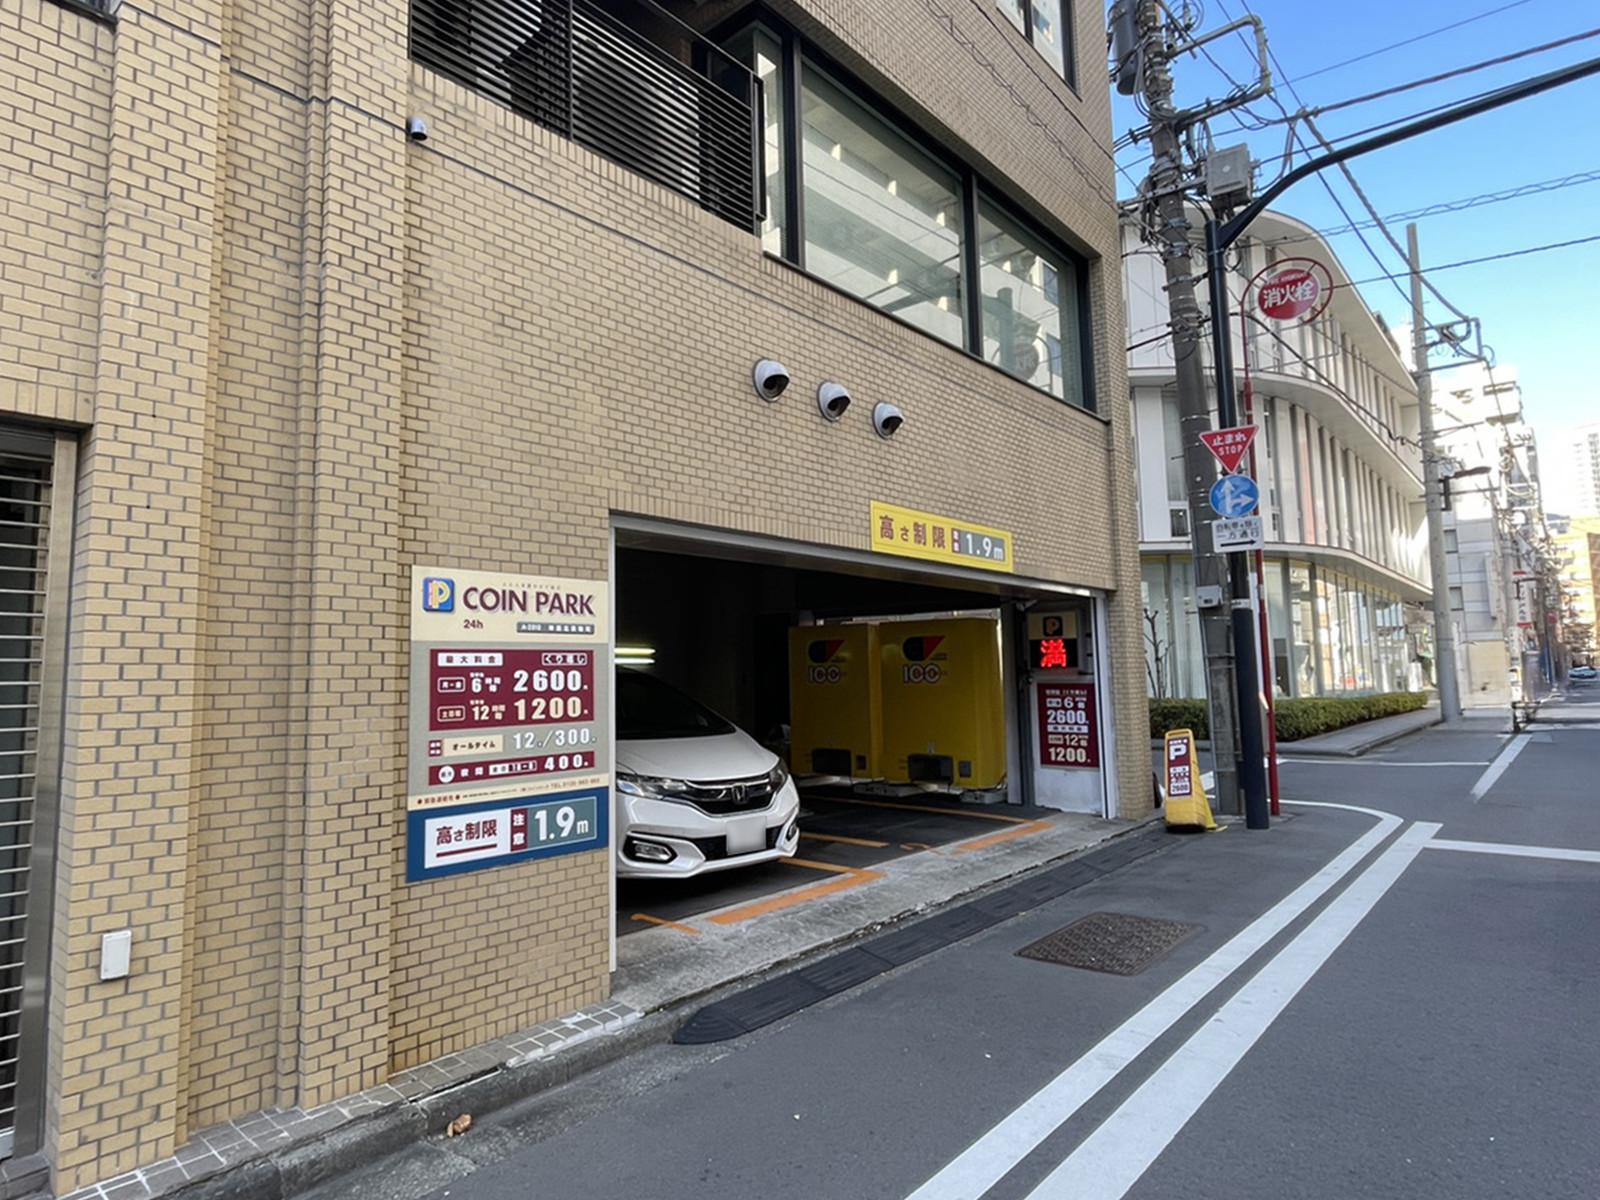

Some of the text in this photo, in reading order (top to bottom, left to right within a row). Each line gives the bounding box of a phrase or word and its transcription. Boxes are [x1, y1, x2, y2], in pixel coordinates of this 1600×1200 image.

[1263, 280, 1314, 309] 消火栓
[1212, 432, 1247, 446] 止まれ
[1218, 444, 1243, 456] STOP
[879, 515, 946, 549] 高さ制限
[966, 533, 1004, 560] 1.9m
[462, 587, 595, 616] COIN PARK
[463, 619, 484, 629] 24h
[1040, 638, 1067, 668] 満
[471, 678, 483, 693] 6
[1064, 696, 1074, 709] 6
[472, 705, 490, 721] 12
[452, 741, 497, 752] オールタイム
[1064, 734, 1078, 746] 12
[1169, 744, 1187, 760] P
[513, 813, 525, 845] 注意
[535, 806, 590, 842] 1.9m
[436, 819, 498, 846] 高さ制限
